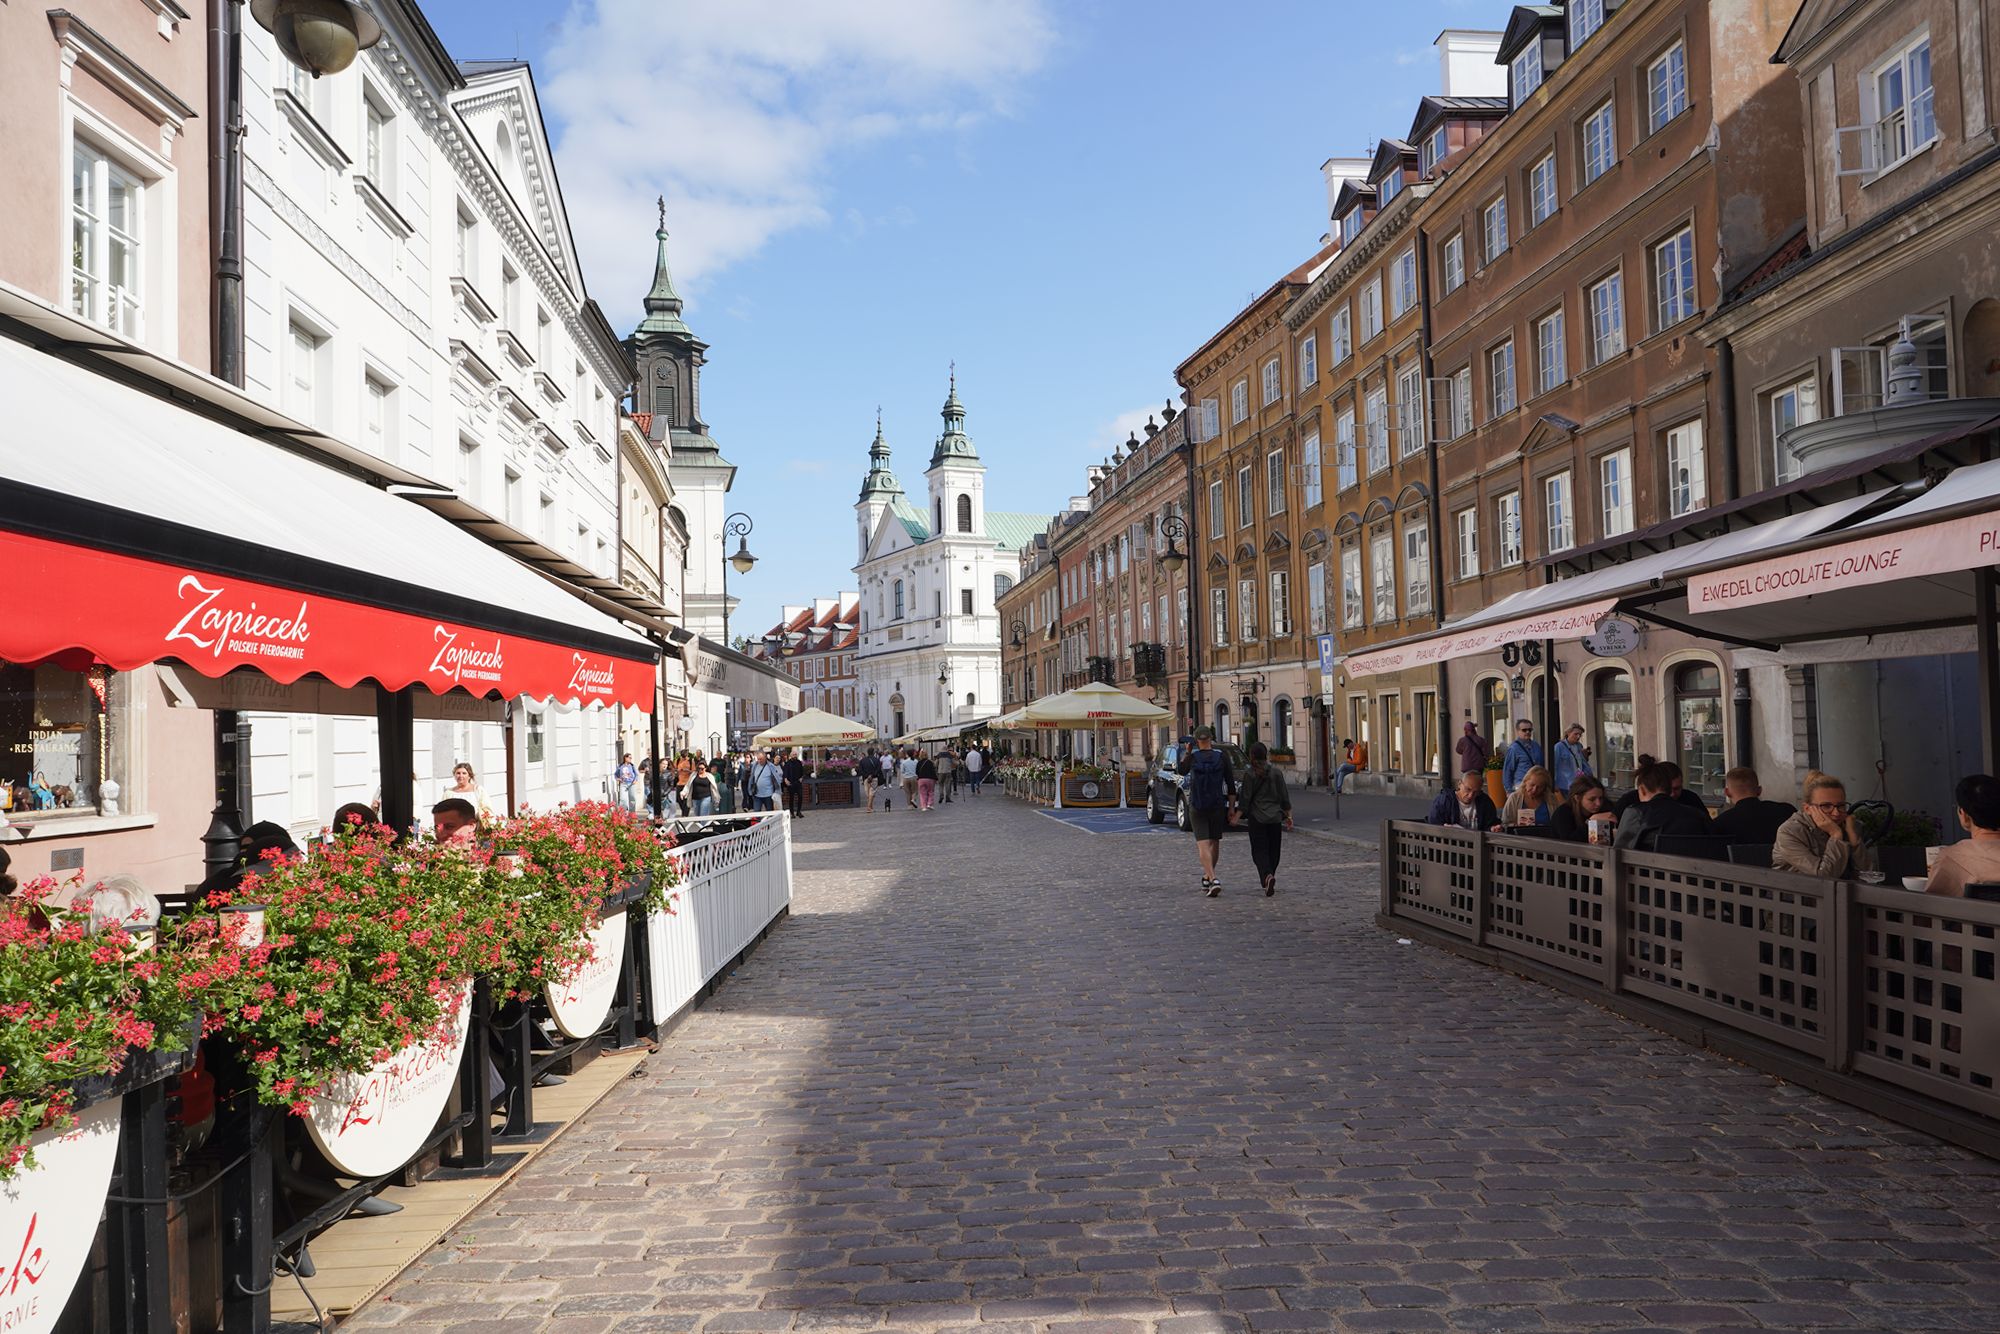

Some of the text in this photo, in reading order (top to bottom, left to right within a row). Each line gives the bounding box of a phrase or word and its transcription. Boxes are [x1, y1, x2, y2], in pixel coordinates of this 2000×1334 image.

[1980, 530, 2000, 552] PI
[1702, 548, 1902, 602] E.WEDEL CHOCOLATE LOUNGE
[165, 575, 310, 657] Zapiecek
[228, 639, 304, 659] POLSKIE PIEROGARNIE
[429, 625, 504, 682] Zapiecek
[1321, 638, 1331, 664] P
[568, 652, 614, 696] Zapiecek
[29, 730, 63, 740] INDIAN
